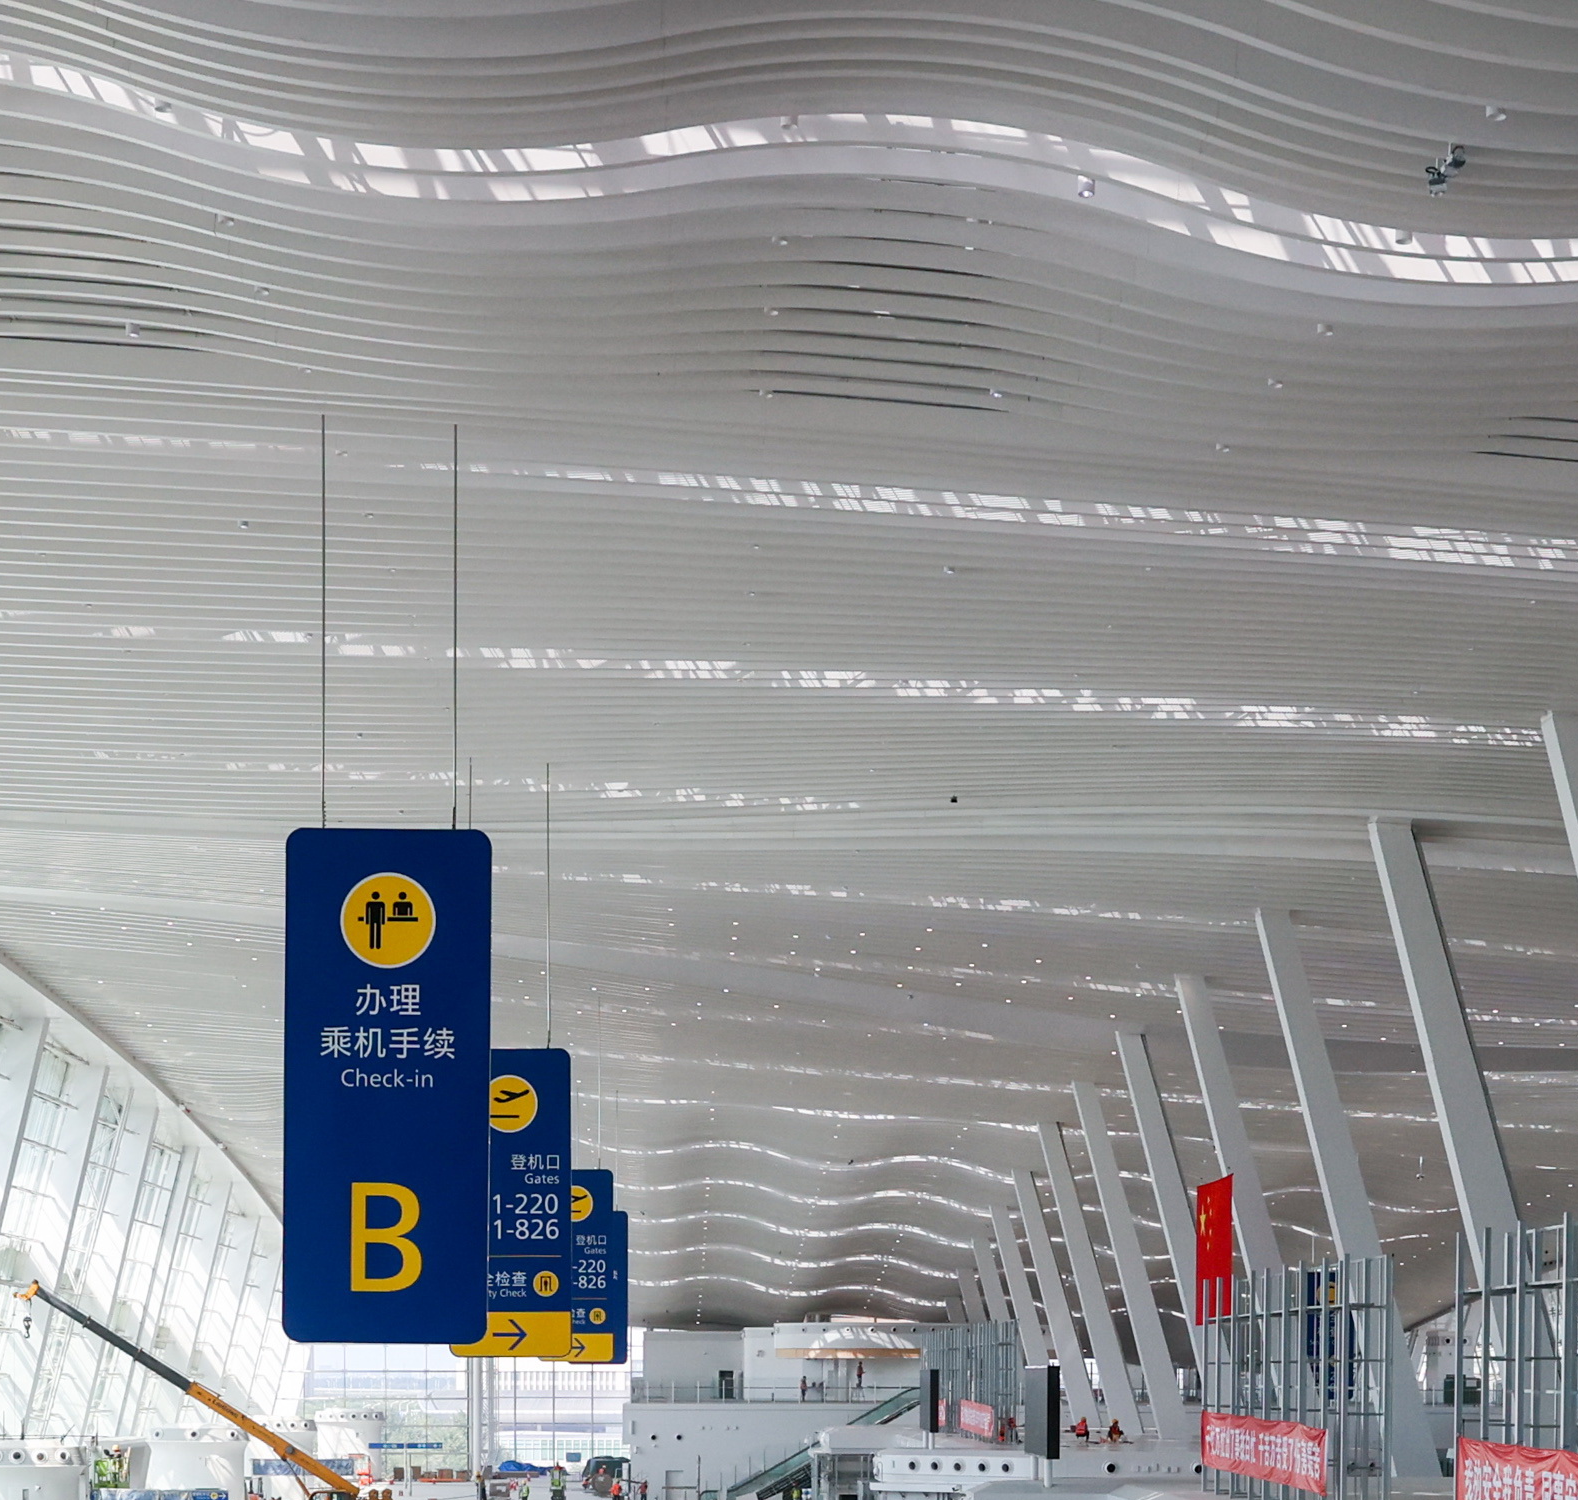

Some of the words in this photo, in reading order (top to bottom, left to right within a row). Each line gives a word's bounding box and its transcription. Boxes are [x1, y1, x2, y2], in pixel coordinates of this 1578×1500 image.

[355, 984, 421, 1015] 办理
[320, 1027, 455, 1059] 乘机手续
[340, 1069, 434, 1088] Check-in
[511, 1154, 560, 1170] 登机口
[524, 1173, 560, 1185] Gates
[350, 1182, 423, 1292] B
[575, 1235, 607, 1245] 登机口
[584, 1247, 607, 1255] Gates
[499, 1288, 527, 1298] Check
